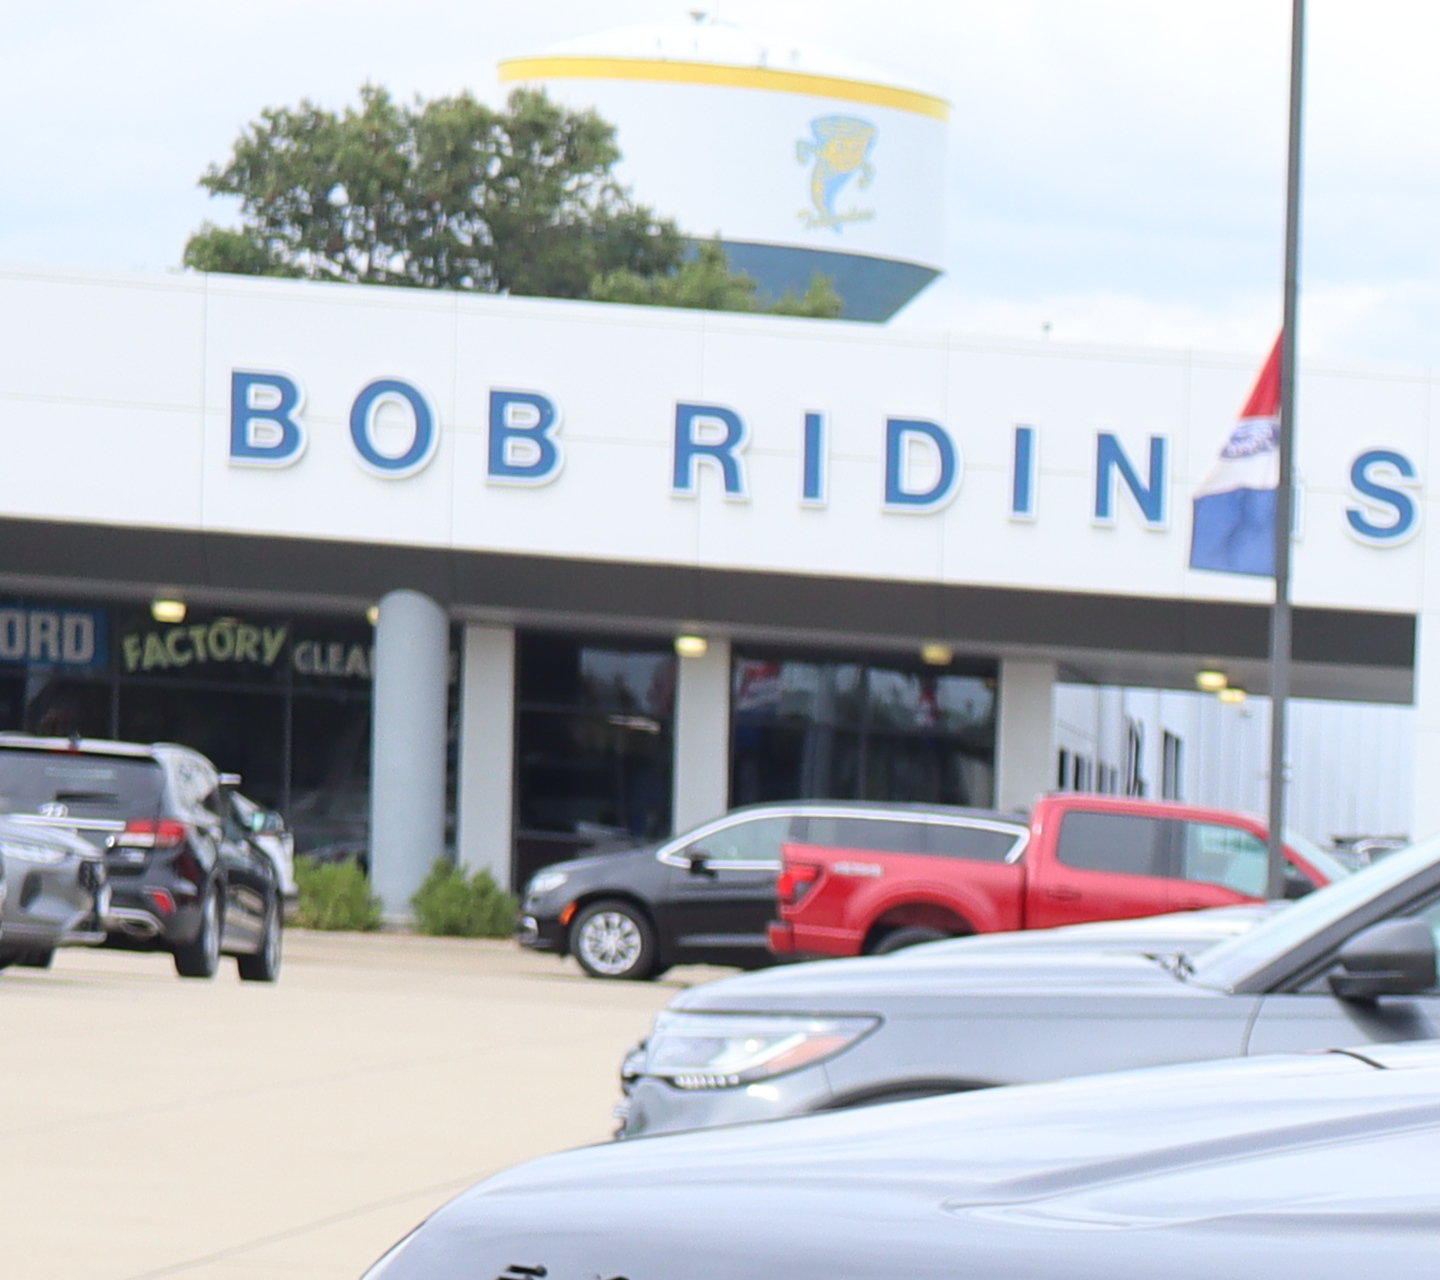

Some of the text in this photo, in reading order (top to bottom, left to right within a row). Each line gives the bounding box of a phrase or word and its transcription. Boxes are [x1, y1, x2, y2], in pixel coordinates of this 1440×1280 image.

[228, 368, 1424, 549] BOB RIDINS
[122, 621, 289, 672] FACTORY
